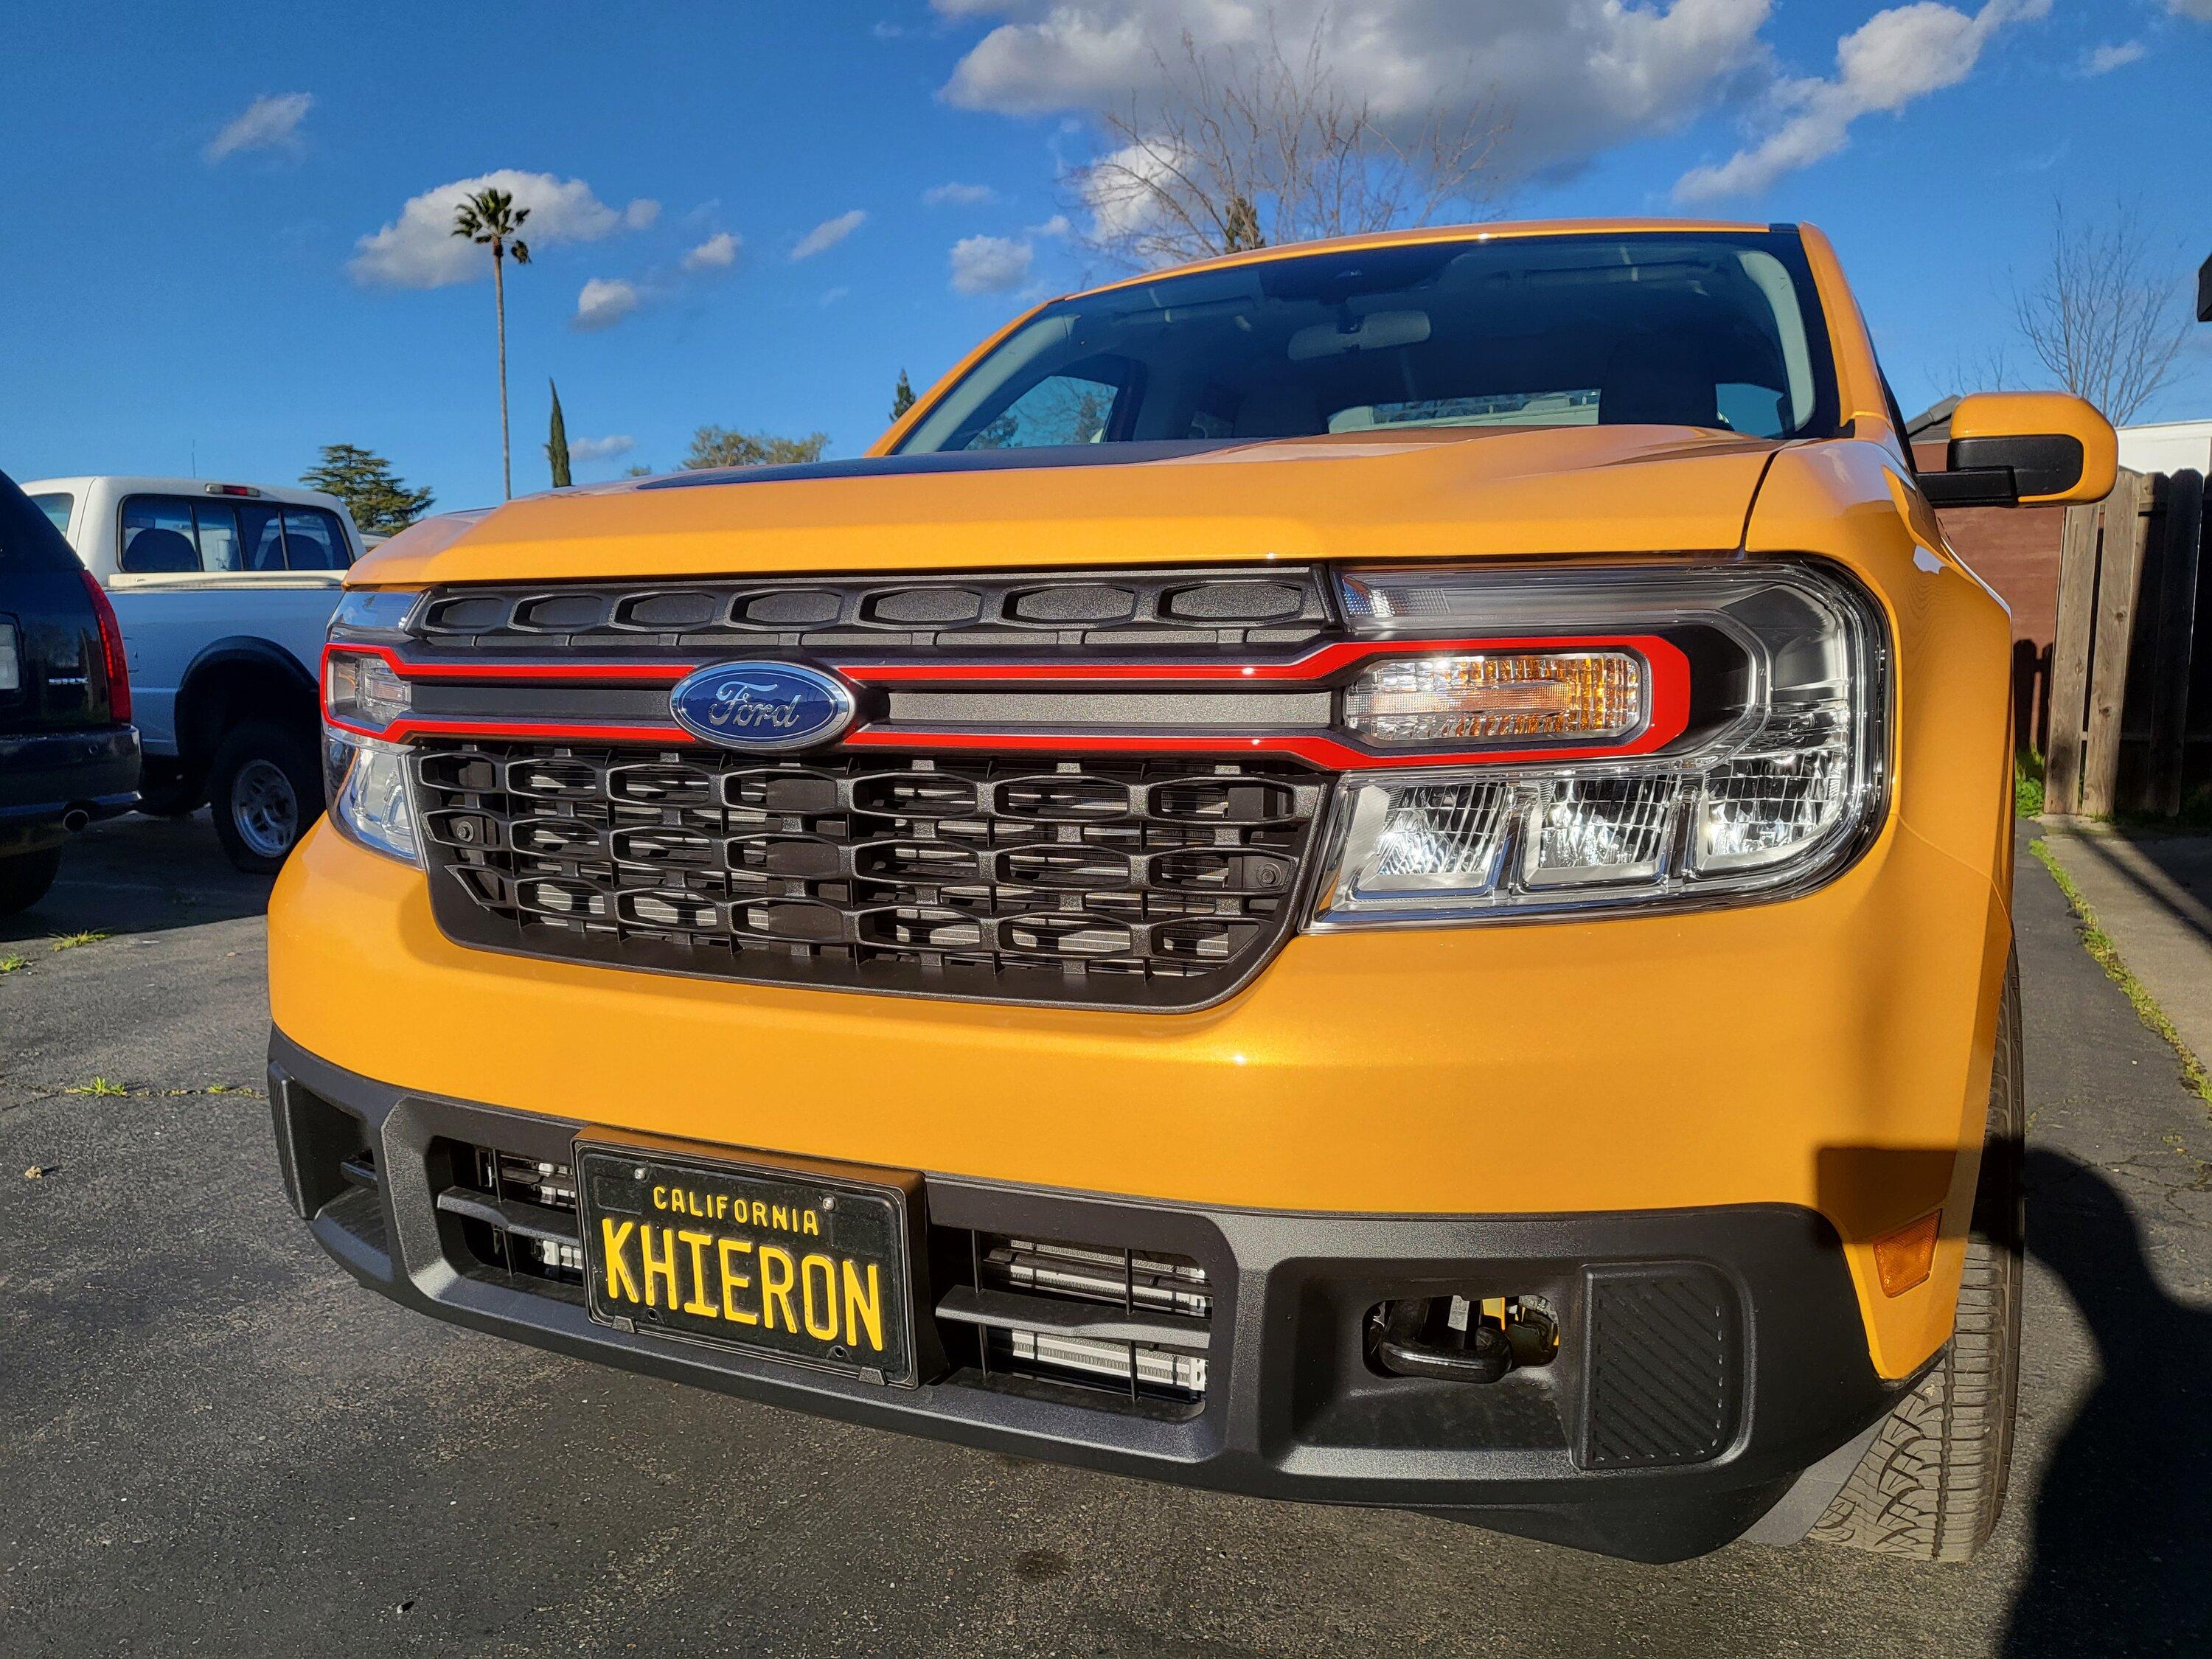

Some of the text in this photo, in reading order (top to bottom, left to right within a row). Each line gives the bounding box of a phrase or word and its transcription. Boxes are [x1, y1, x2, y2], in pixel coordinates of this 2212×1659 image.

[709, 681, 801, 728] Ford
[653, 1186, 819, 1236] CALIFORNIA
[601, 1218, 883, 1352] KHIERON
